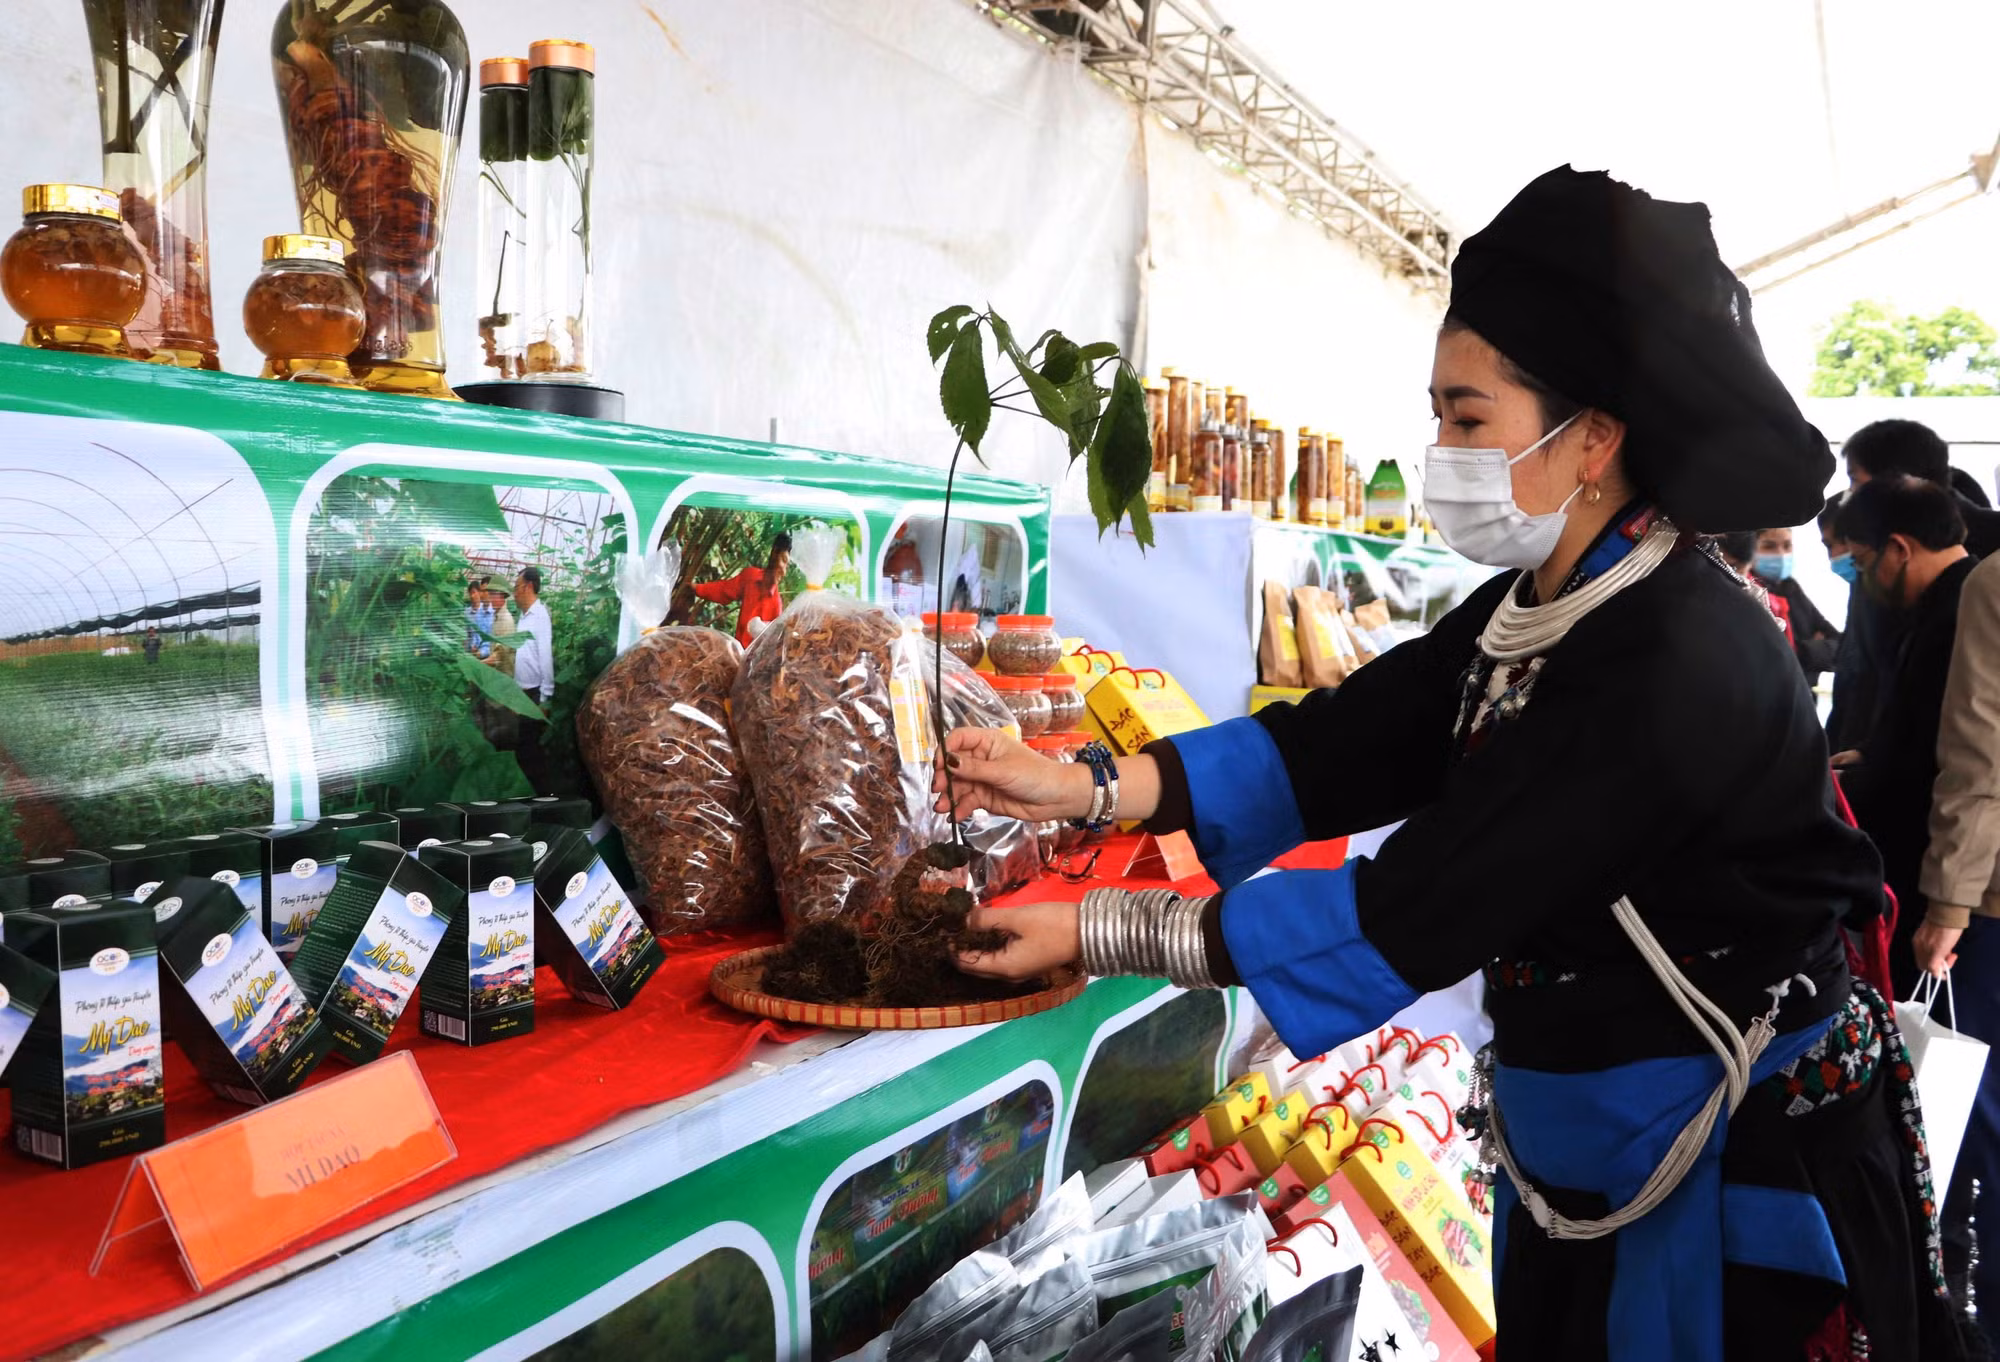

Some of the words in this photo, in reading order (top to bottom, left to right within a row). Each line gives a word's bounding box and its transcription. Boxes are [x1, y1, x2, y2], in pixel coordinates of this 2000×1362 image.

[599, 899, 621, 928] Dao
[503, 929, 527, 953] Dao
[389, 949, 416, 976] Dao
[249, 970, 277, 1004] Dao
[114, 1016, 151, 1045] Dao
